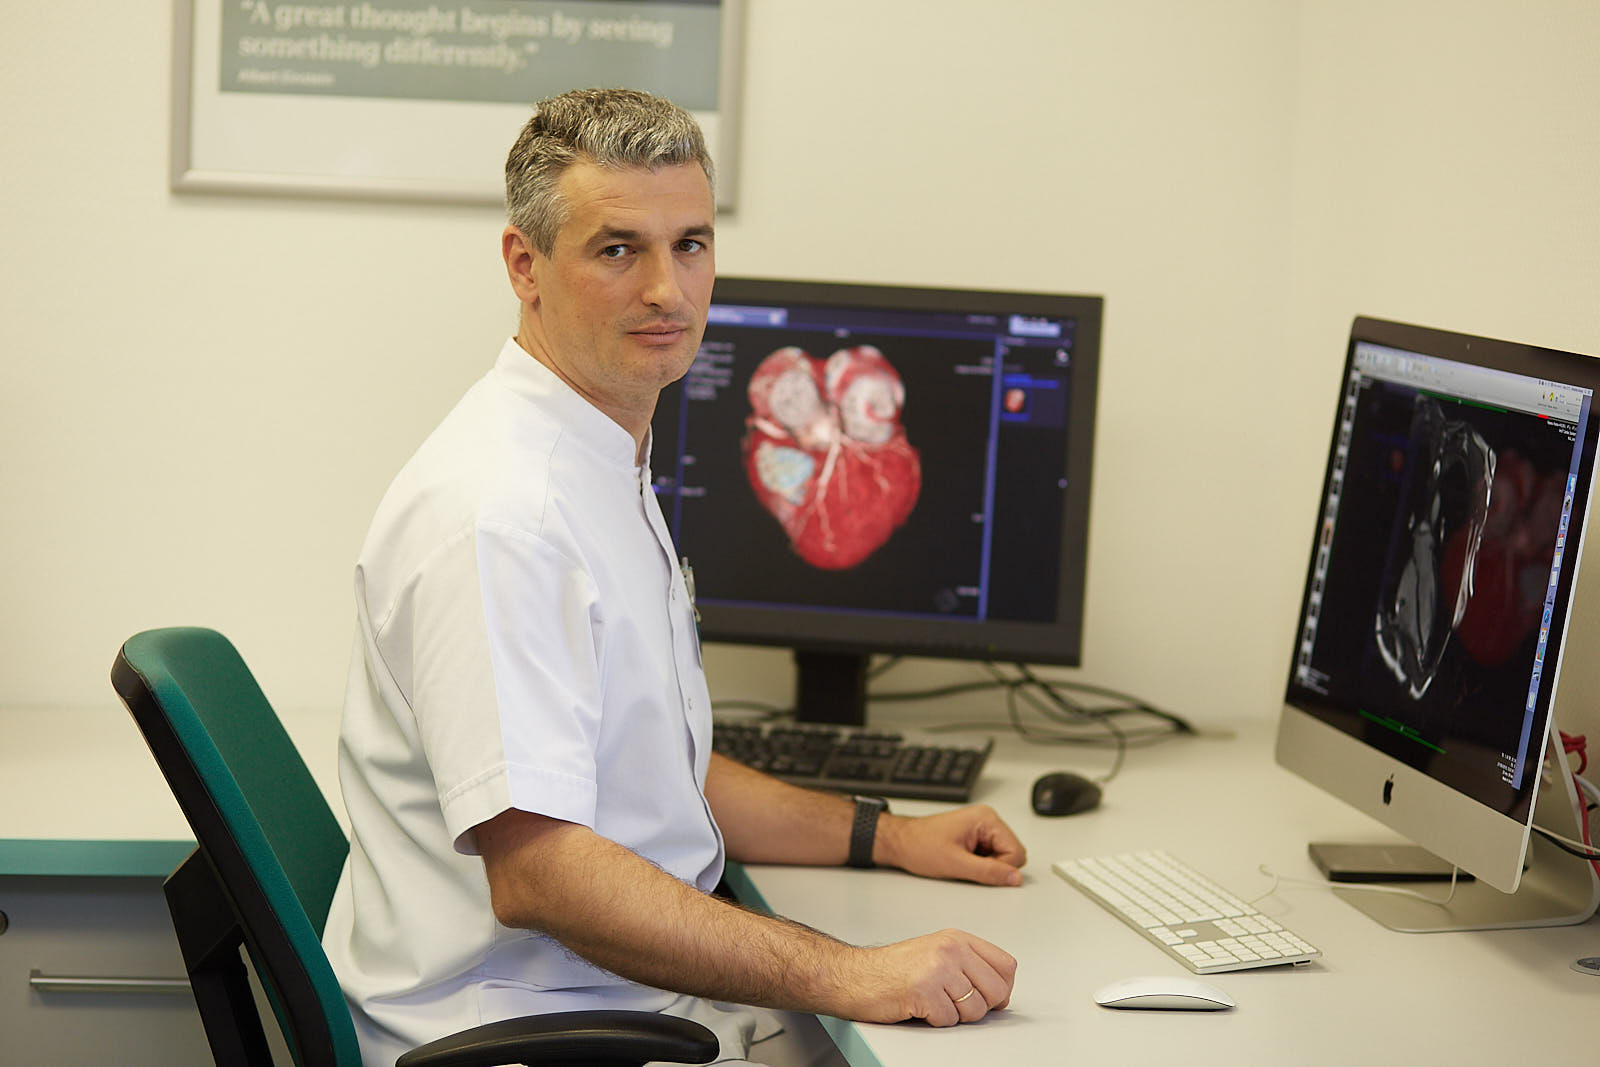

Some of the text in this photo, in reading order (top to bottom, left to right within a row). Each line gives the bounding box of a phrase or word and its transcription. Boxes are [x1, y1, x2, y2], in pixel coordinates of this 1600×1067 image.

[274, 5, 345, 31] great
[351, 2, 456, 36] thought
[459, 6, 548, 41] begins
[551, 10, 582, 45] by
[587, 13, 674, 49] seeing
[238, 33, 381, 69] something
